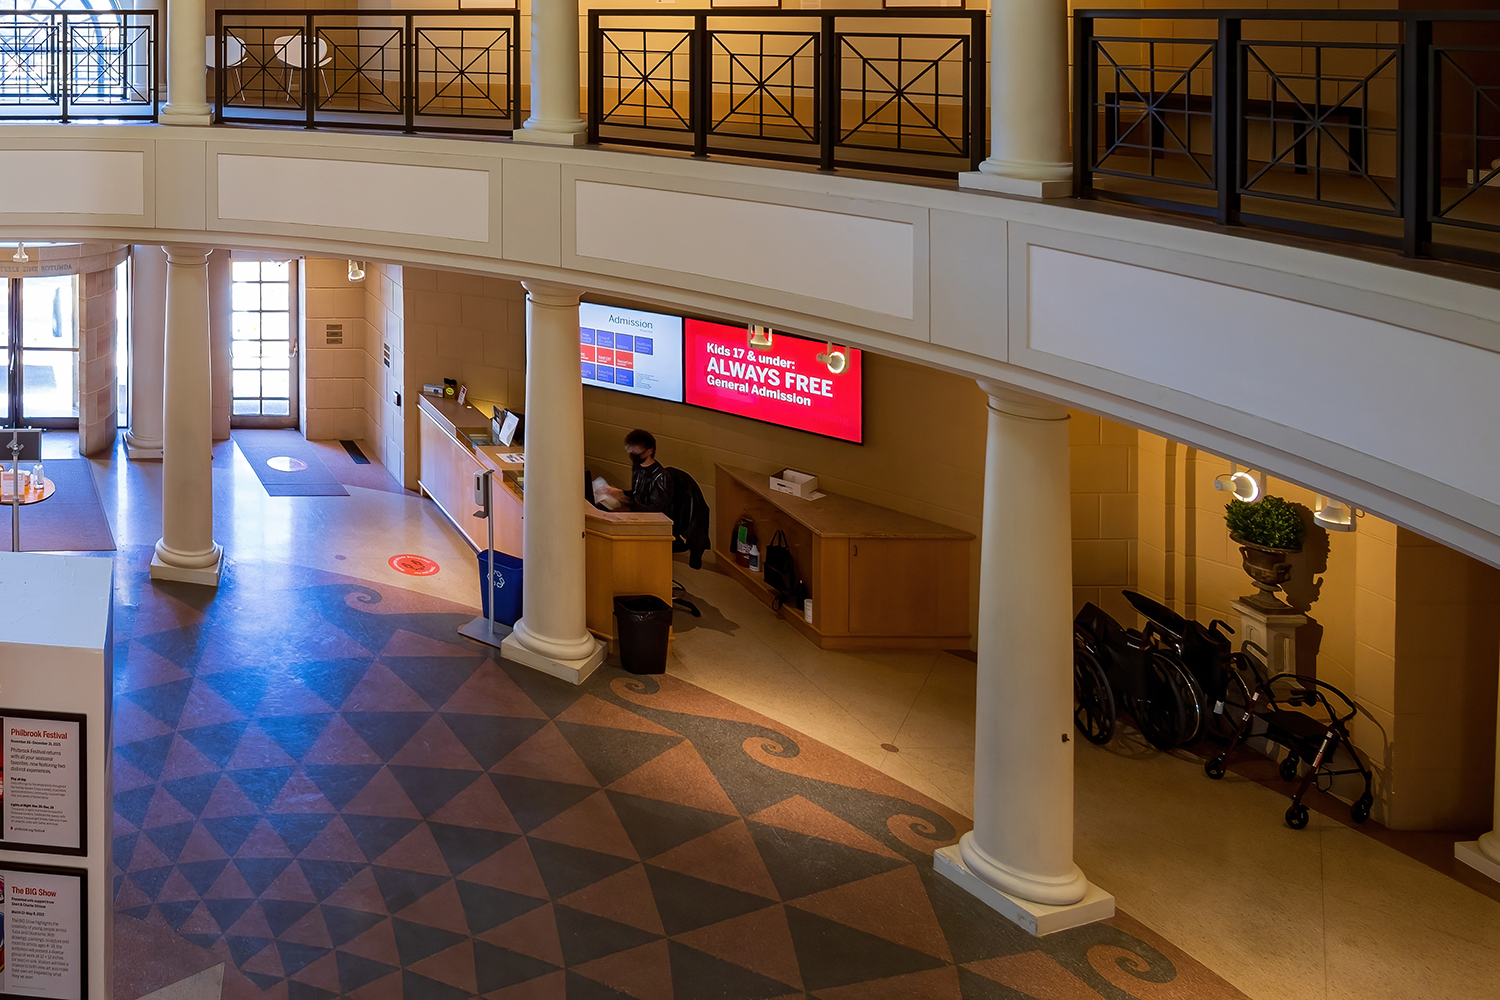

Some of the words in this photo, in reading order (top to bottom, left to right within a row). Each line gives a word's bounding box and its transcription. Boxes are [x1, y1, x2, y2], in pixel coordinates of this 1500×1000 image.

[608, 314, 653, 329] Admission
[706, 342, 731, 357] Kids
[732, 347, 745, 359] 17
[746, 350, 757, 362] &
[758, 354, 796, 370] under:
[706, 356, 780, 386] ALWAYS
[785, 372, 833, 398] FREE
[706, 374, 749, 393] General
[751, 384, 811, 406] Admission
[11, 728, 42, 738] Philbrook
[42, 730, 68, 740] Festival
[11, 886, 24, 895] The
[25, 887, 37, 896] BIG
[38, 888, 57, 897] Show
